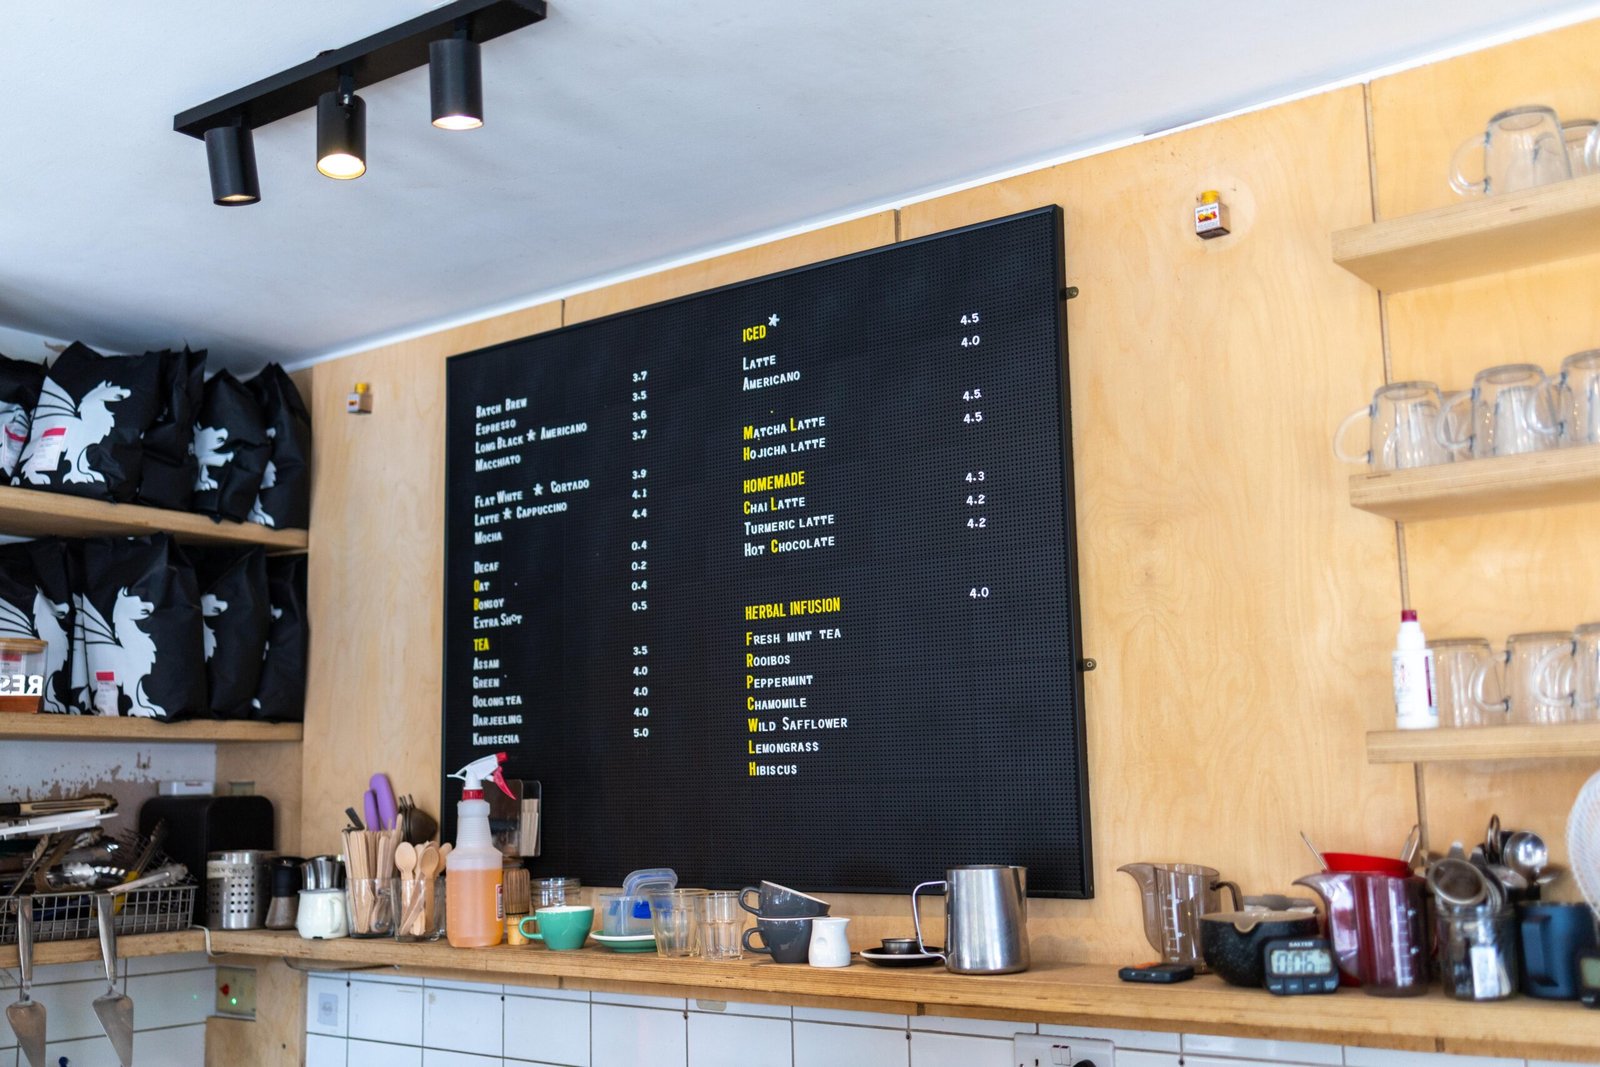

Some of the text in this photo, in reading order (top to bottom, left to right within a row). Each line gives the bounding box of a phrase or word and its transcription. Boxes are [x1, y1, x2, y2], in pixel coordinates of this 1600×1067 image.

[960, 313, 979, 325] 4.5
[743, 325, 766, 342] ICED
[961, 335, 980, 347] 4.0
[743, 355, 776, 371] LATTE
[633, 371, 647, 382] 3.7
[743, 371, 800, 391] AMERICANO
[632, 390, 647, 401] 3.5
[963, 389, 982, 401] 4.5
[476, 398, 527, 418] BATCH BREW
[632, 410, 647, 421] 3.6
[963, 411, 983, 424] 4.5
[476, 419, 516, 436] ESPRESSO
[744, 416, 825, 440] MATCHA LATTE
[475, 422, 587, 454] LONG BLACK AMERICANO
[632, 429, 647, 440] 3.7
[743, 437, 826, 461] HOJICHA LATTE
[475, 455, 521, 472] MACCHIATO
[632, 469, 647, 480] 3.9
[965, 471, 985, 483] 4.3
[744, 471, 805, 494] HOMEMADE
[475, 479, 590, 508] FLAT WHITE CORTADO
[632, 488, 647, 499] 4.1
[966, 494, 985, 506] 4.2
[744, 497, 805, 514] CHAI LATTE
[475, 502, 567, 526] LATTE CAPPUCCINO
[632, 508, 647, 519] 4.4
[744, 514, 834, 535] TURMERIC LATTE
[967, 517, 986, 528] 4.2
[475, 531, 502, 544] MOCHA
[631, 540, 647, 551] 0.4
[744, 536, 835, 557] HOT CHOCOLATE
[474, 561, 499, 574] DECAF
[631, 561, 647, 571] 0.2
[474, 580, 490, 592] OAT
[631, 580, 647, 591] 0.4
[969, 587, 989, 599] 4.0
[632, 601, 647, 611] 0.5
[745, 597, 840, 620] HERBAL INFUSION
[474, 613, 522, 629] EXTRA SHOT
[746, 628, 841, 646] FRESH MINT TEA
[474, 638, 489, 651] TEA
[633, 646, 648, 655] 3.5
[746, 653, 790, 667] ROOIBOS
[633, 666, 648, 676] 4.0
[747, 675, 813, 689] PEPPERMINT
[633, 687, 648, 696] 4.0
[505, 695, 522, 705] TEA
[747, 697, 807, 710] CHAMOMILE
[634, 707, 649, 717] 4.0
[748, 716, 848, 732] WILD SAFFLOWER
[634, 728, 649, 737] 5.0
[749, 740, 819, 754] LEMONGRASS
[749, 762, 797, 776] HIBISCUS
